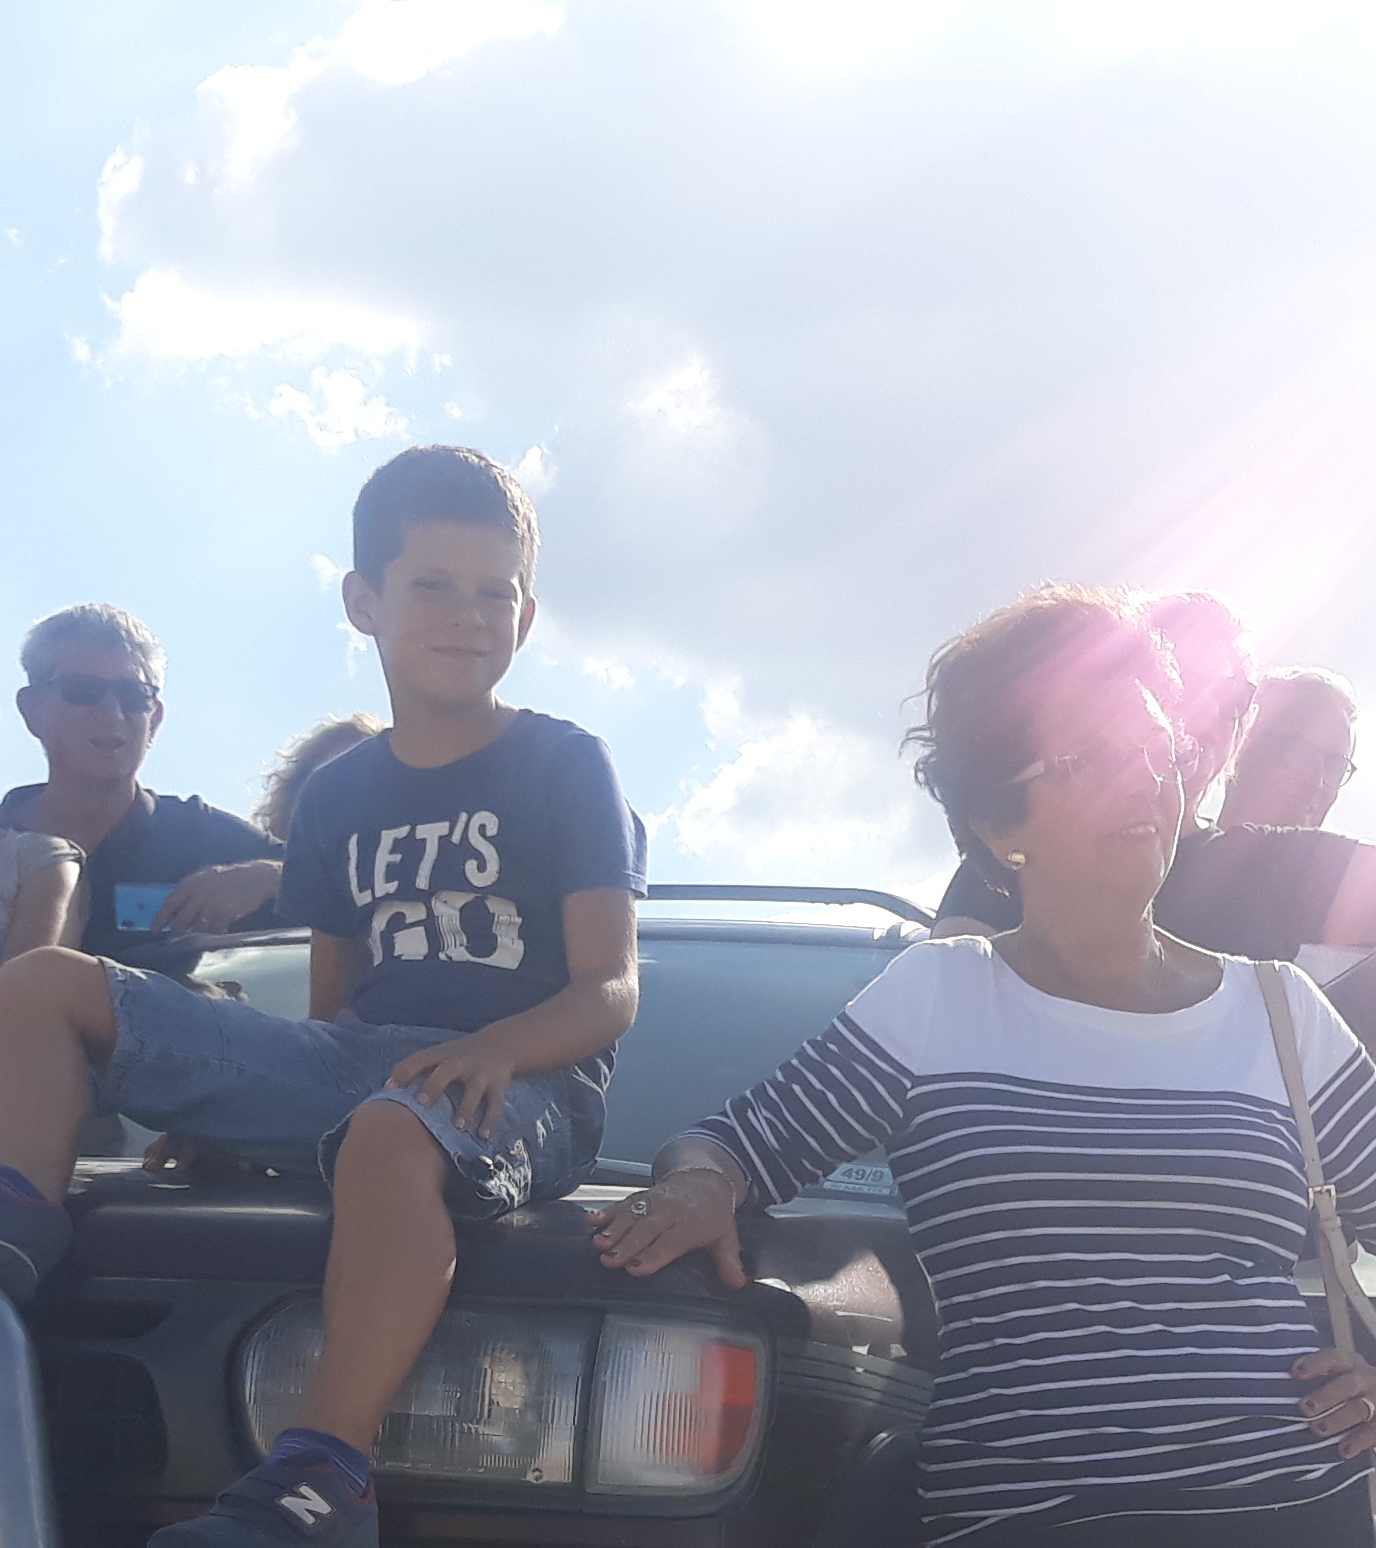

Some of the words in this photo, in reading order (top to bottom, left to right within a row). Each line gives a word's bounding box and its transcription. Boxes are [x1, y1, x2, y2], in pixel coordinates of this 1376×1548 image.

[347, 810, 501, 908] LET'S
[367, 890, 525, 971] GO
[277, 1481, 336, 1526] N
